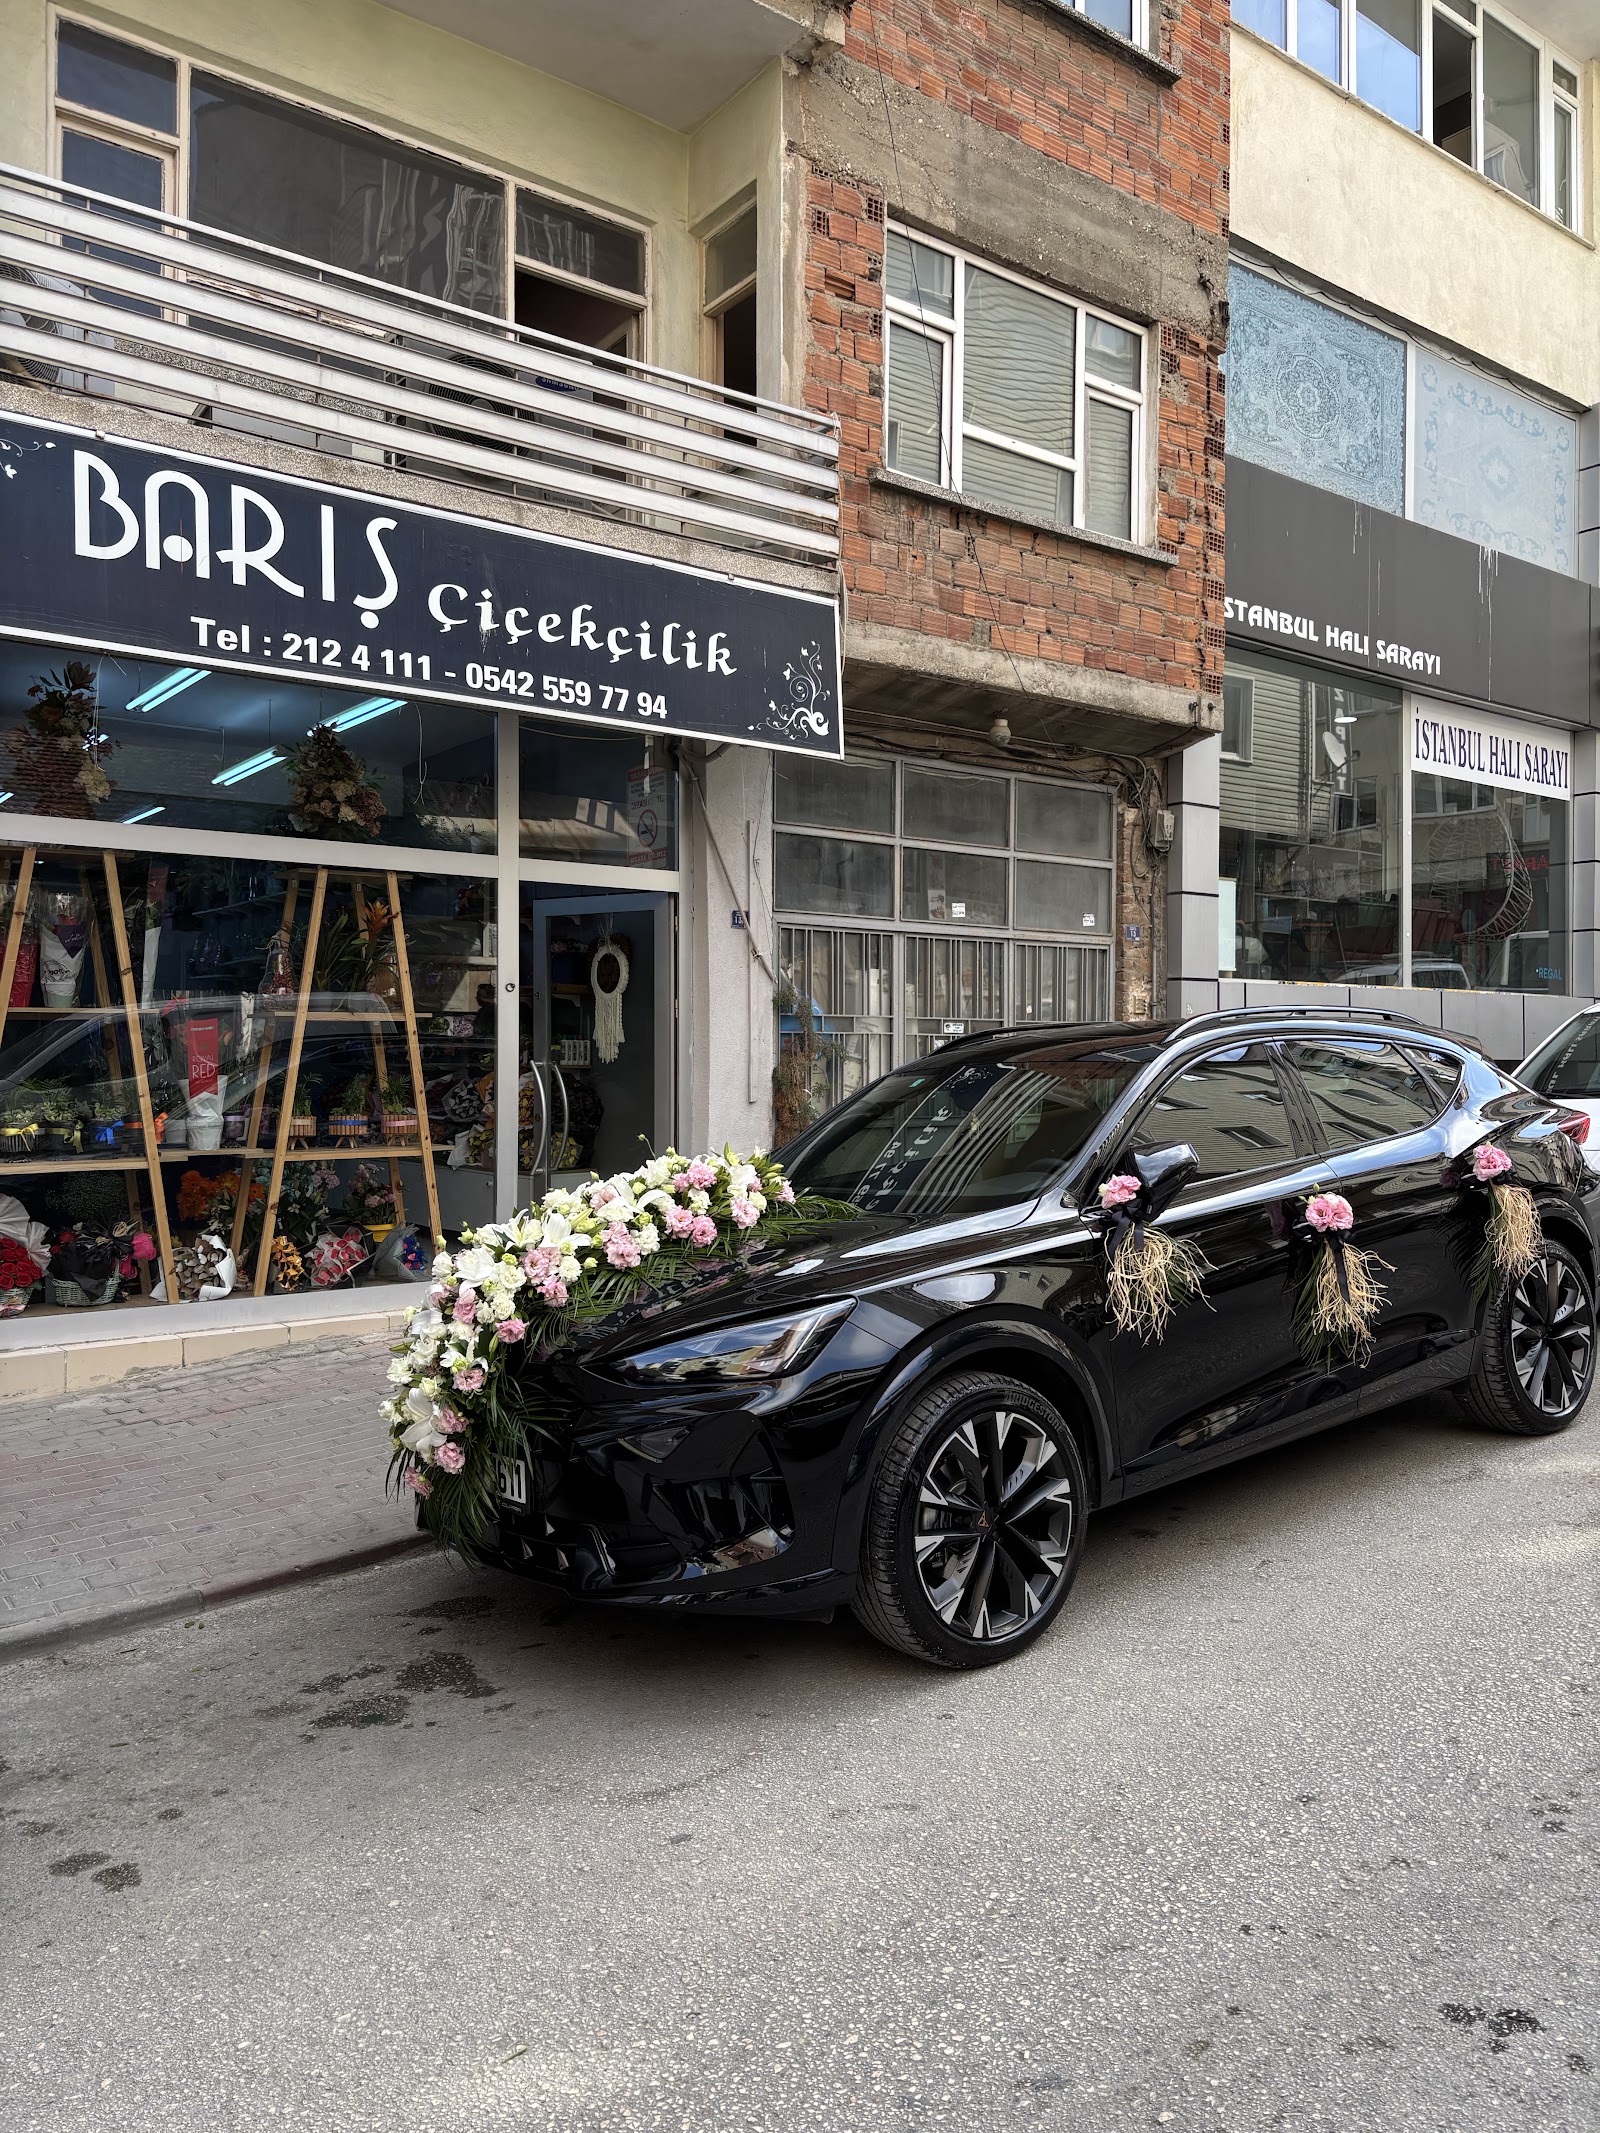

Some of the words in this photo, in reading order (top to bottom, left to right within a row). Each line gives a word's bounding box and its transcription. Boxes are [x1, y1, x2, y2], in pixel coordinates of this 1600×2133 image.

[74, 450, 399, 629] BARIŞ
[428, 584, 738, 676] Çiçekçilik
[191, 616, 250, 654] Tel
[282, 633, 342, 668] 212
[352, 645, 371, 672] 4
[381, 649, 431, 681] 111
[466, 663, 535, 698] 0542
[543, 675, 592, 707] 559
[599, 685, 630, 712] 77
[637, 691, 668, 719] 94
[1224, 597, 1319, 642] STANBUL
[1326, 625, 1369, 656] HALI
[1377, 640, 1441, 676] SARAYI
[1415, 706, 1485, 772] İSTANBUL
[1489, 735, 1521, 780] HALI
[1524, 743, 1569, 789] SARAYI
[1538, 967, 1562, 980] REGAL
[192, 1063, 216, 1079] RED
[1003, 1390, 1064, 1435] BRIDGESTONE
